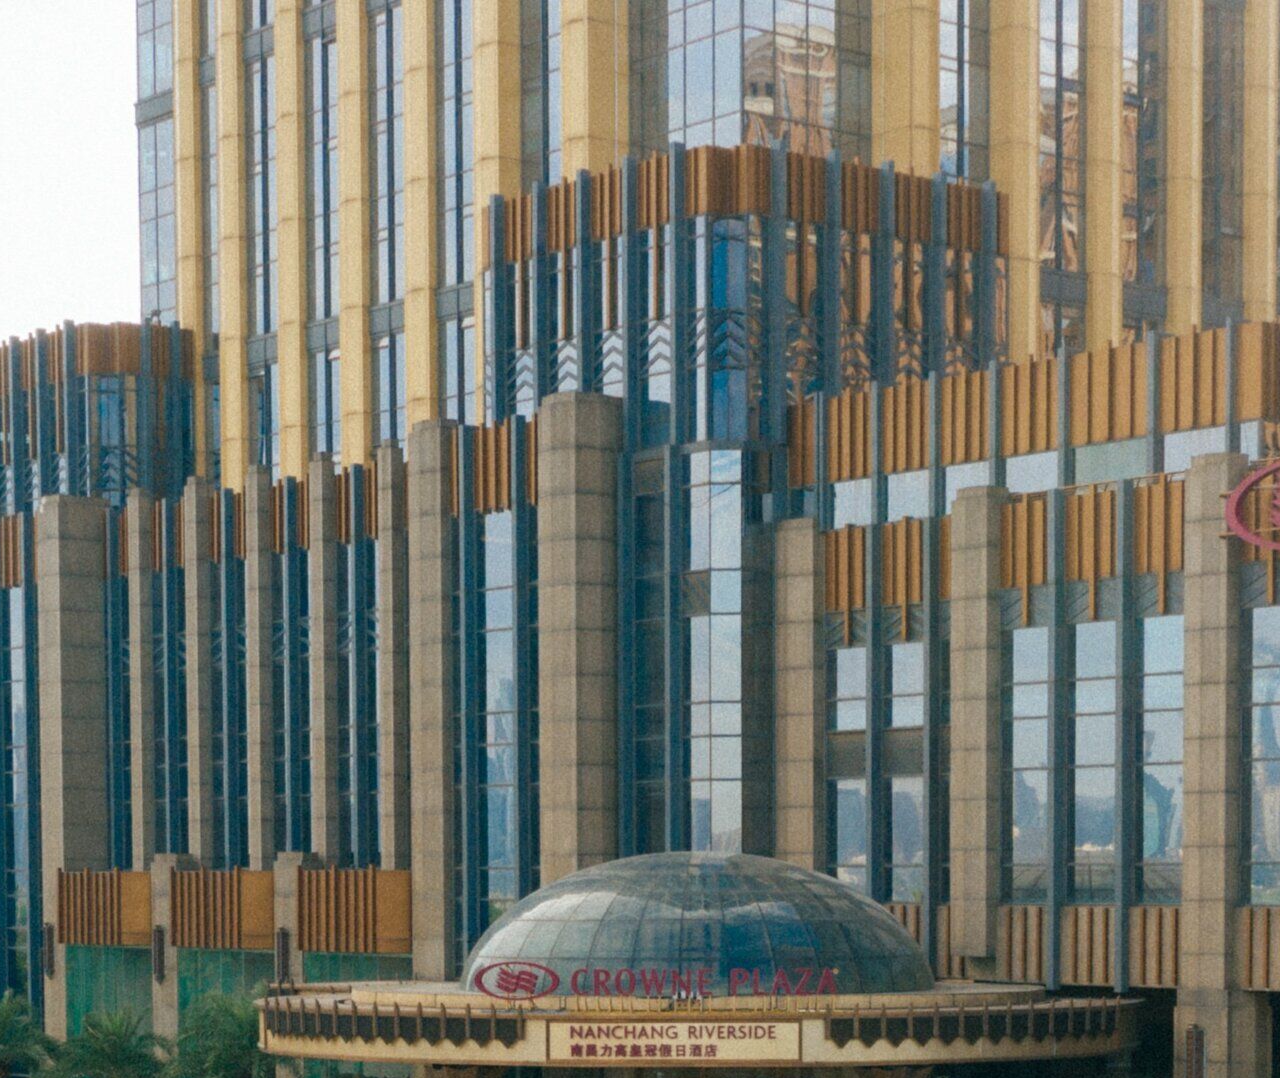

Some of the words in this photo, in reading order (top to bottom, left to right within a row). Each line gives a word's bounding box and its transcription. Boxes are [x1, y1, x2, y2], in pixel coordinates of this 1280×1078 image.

[571, 967, 713, 996] CROWNE
[730, 967, 837, 996] PLAZA
[570, 1025, 678, 1039] NANCHANG
[688, 1025, 776, 1039] RIVERSIDE
[571, 1043, 717, 1057] 南昌力高皇冠假日酒店
